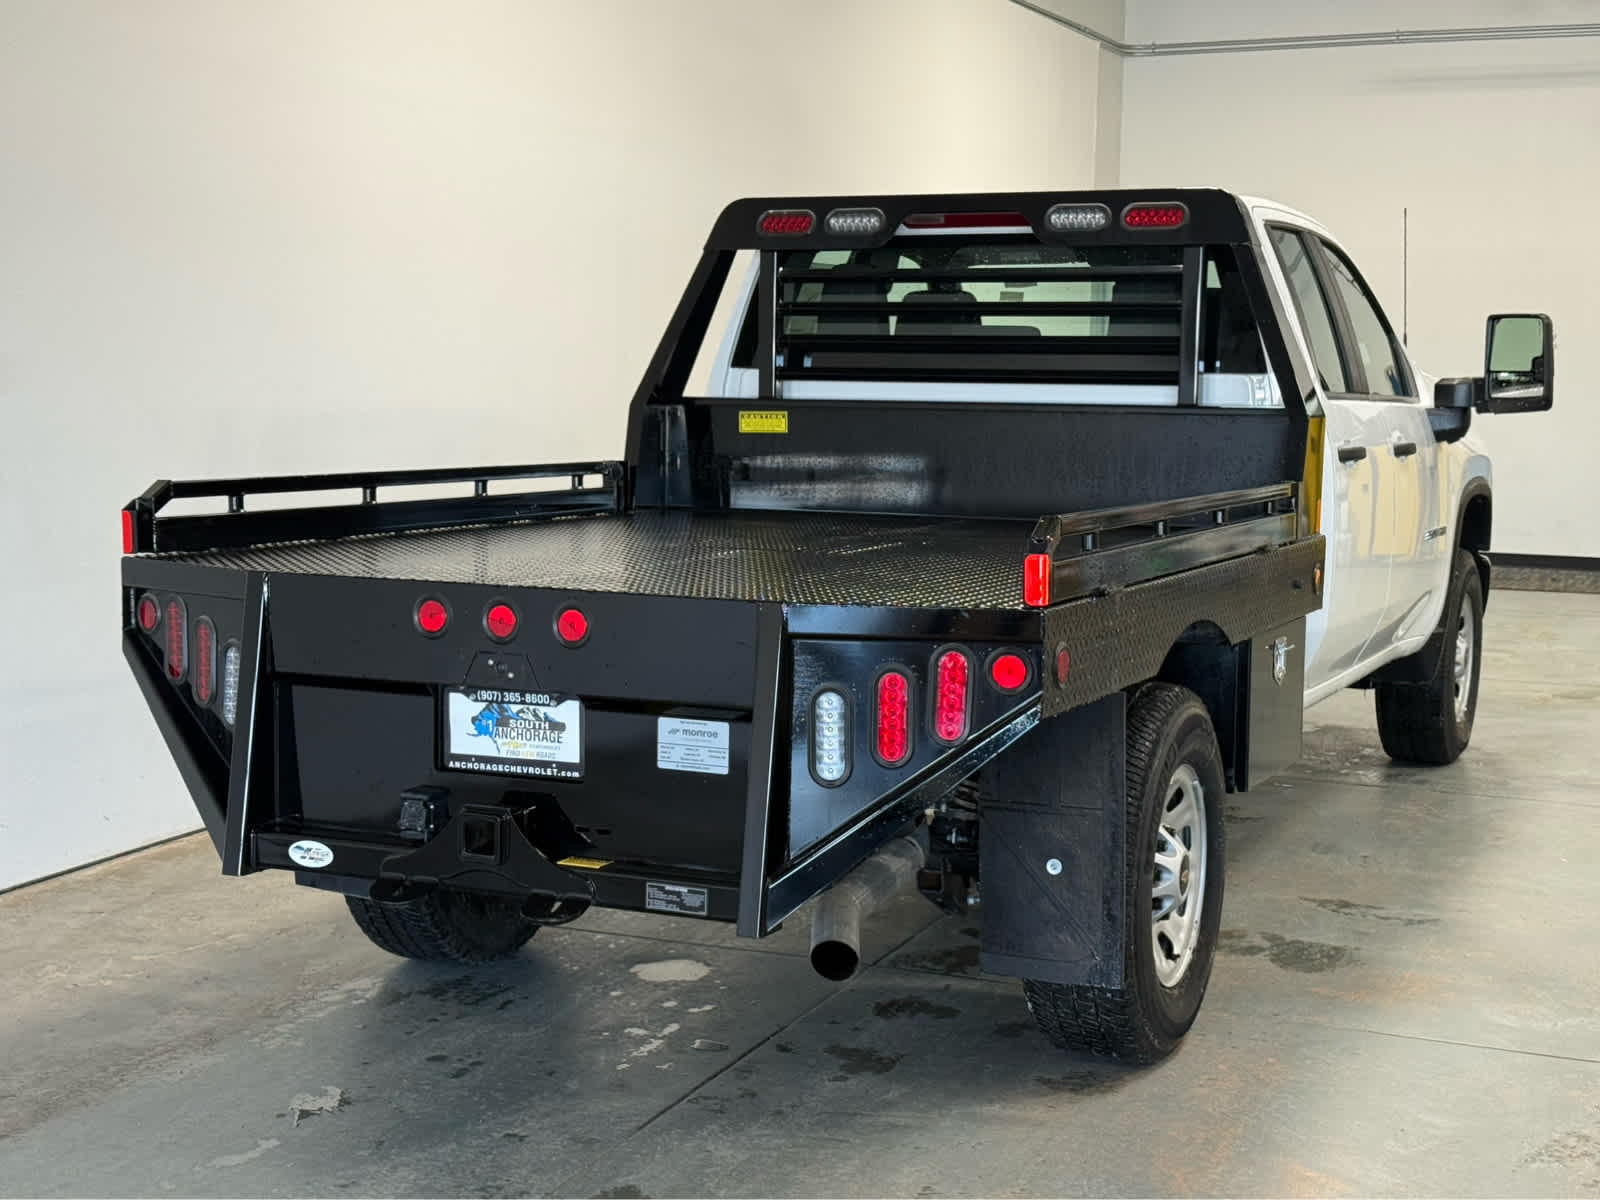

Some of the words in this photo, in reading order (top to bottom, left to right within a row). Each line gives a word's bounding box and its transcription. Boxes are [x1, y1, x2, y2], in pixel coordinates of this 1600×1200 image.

[477, 690, 501, 701] (907)
[503, 691, 550, 704] 365-8600
[509, 719, 549, 730] SOUTH
[494, 727, 563, 744] ANCHORAGE
[682, 728, 719, 739] monroe
[448, 761, 580, 777] ANCHORAGECHEVROLET.com
